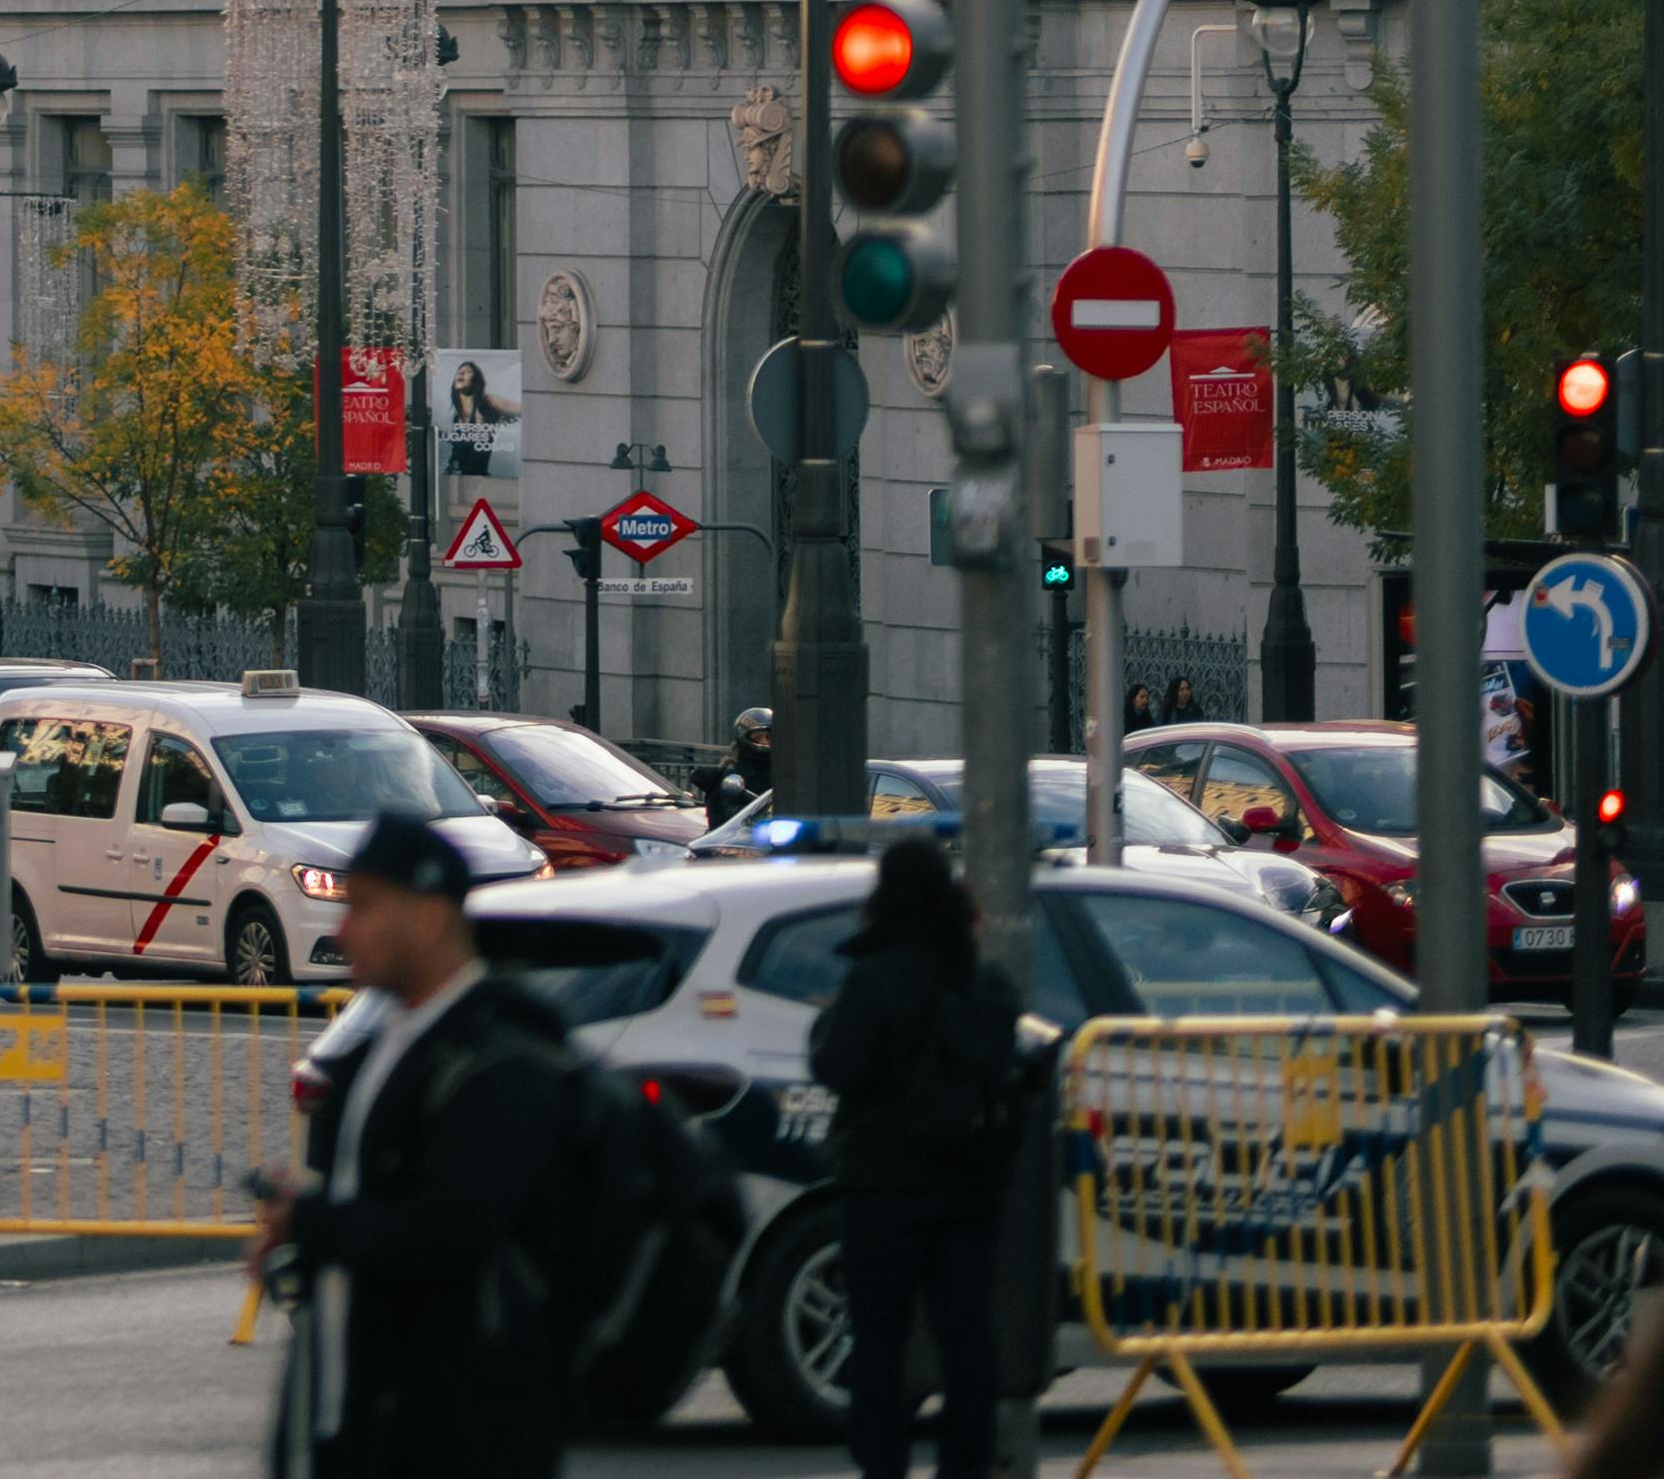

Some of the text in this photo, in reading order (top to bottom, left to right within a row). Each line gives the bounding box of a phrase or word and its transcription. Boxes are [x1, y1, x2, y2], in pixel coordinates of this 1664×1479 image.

[1189, 381, 1259, 399] TEATRO
[342, 395, 390, 410] EATRO
[1193, 398, 1267, 415] ESPAÑOL
[342, 409, 397, 424] SPAÑOL
[621, 519, 670, 536] Metro
[597, 580, 688, 594] Banco de España
[1525, 929, 1566, 946] 0730
